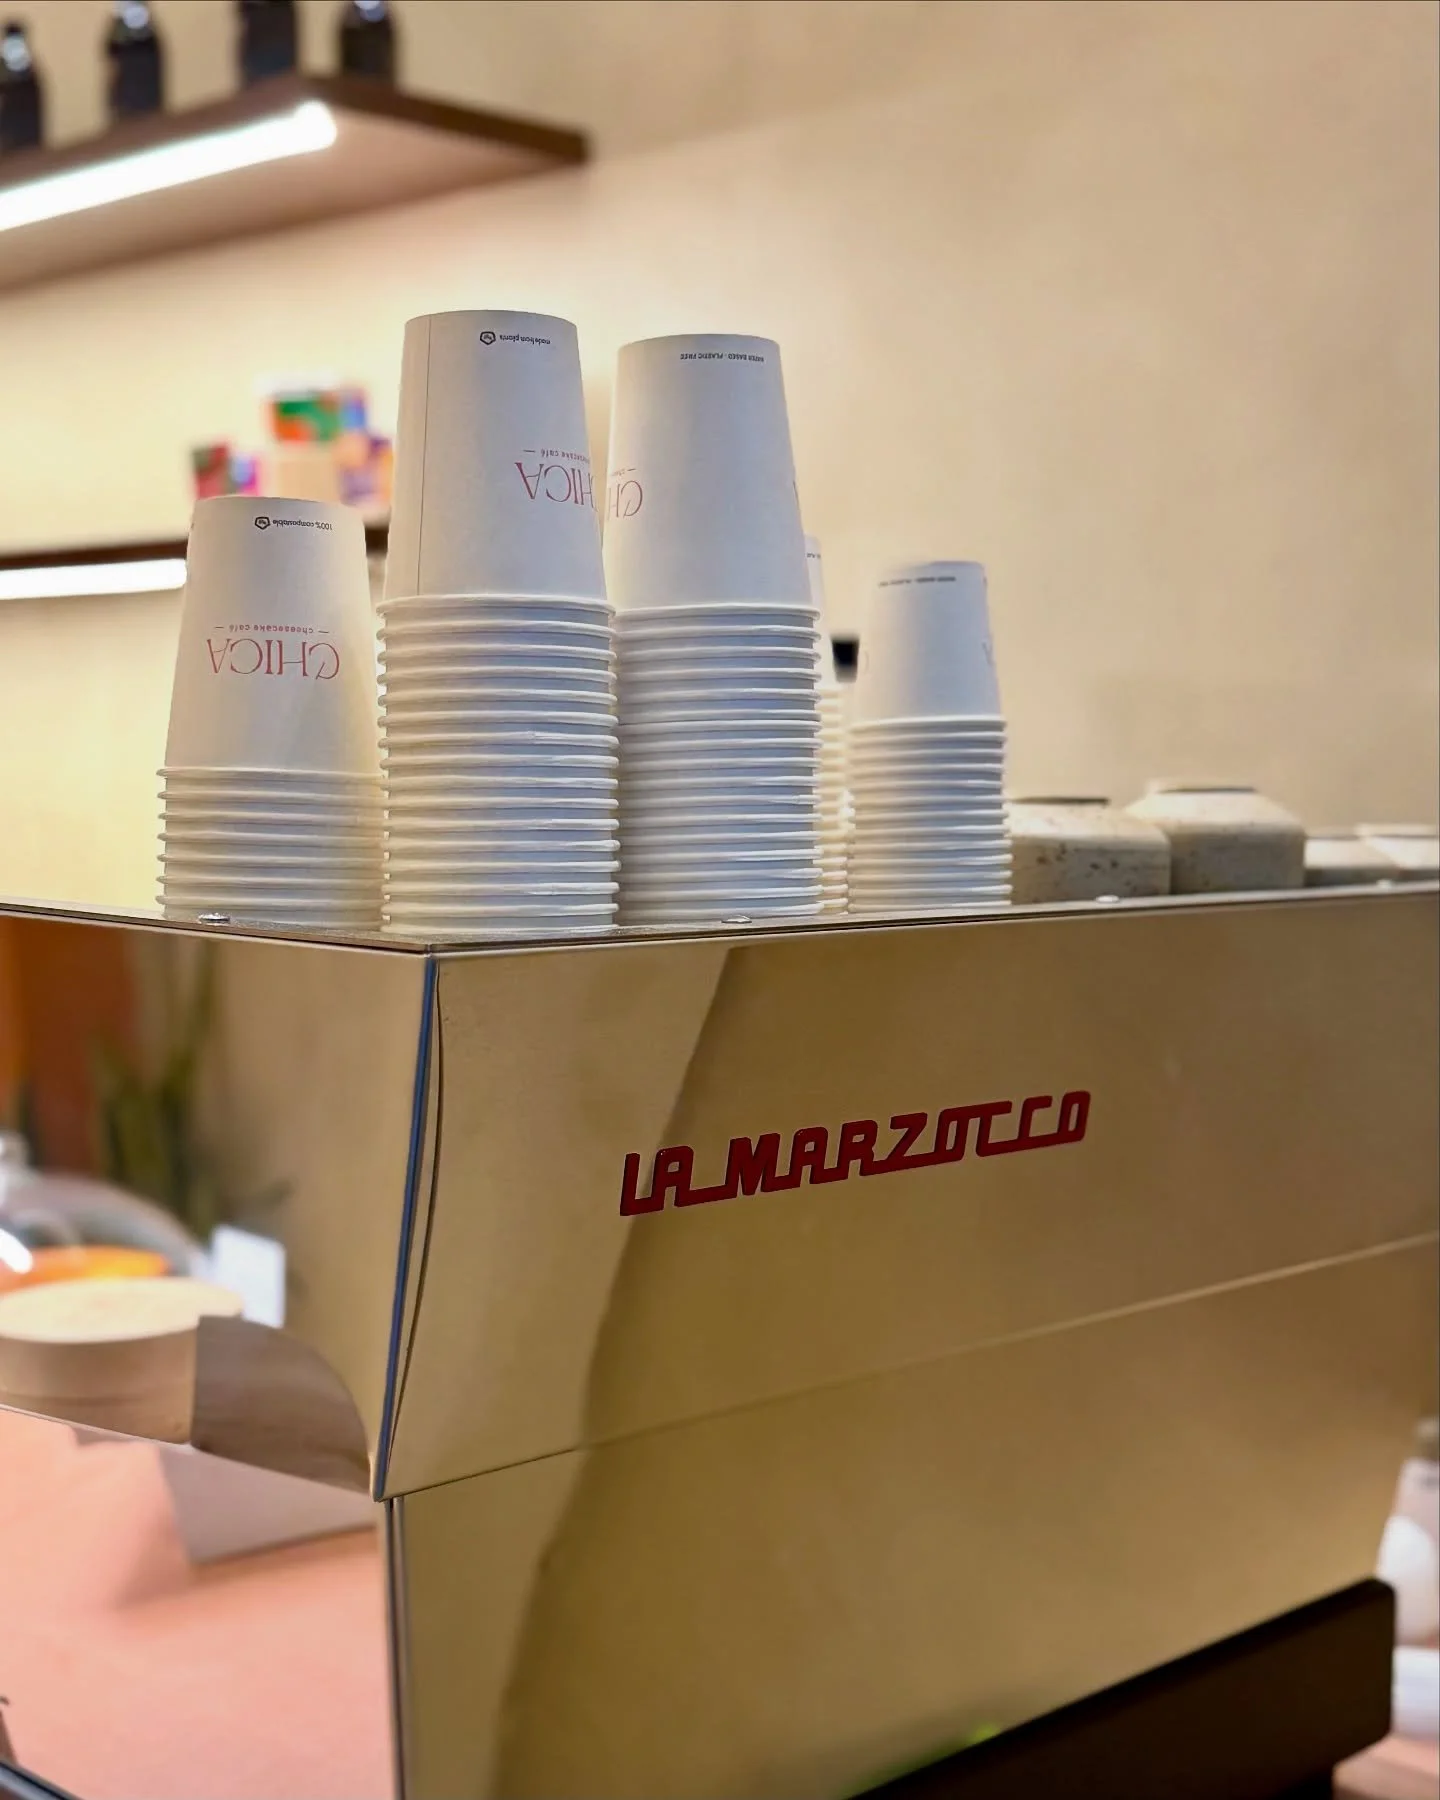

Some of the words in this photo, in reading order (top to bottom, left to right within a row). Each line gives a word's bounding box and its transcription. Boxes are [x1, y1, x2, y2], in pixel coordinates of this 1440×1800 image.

[499, 333, 520, 343] plants
[534, 337, 551, 346] made
[680, 352, 697, 360] FREE
[698, 352, 723, 361] PLASTIC
[727, 353, 747, 361] BASED
[514, 461, 598, 513] HICA
[272, 519, 315, 528] compostable
[315, 521, 333, 531] 100%
[228, 624, 251, 633] café
[253, 624, 314, 635] cheesecake
[206, 638, 340, 680] CHICA
[619, 1145, 697, 1217] LA
